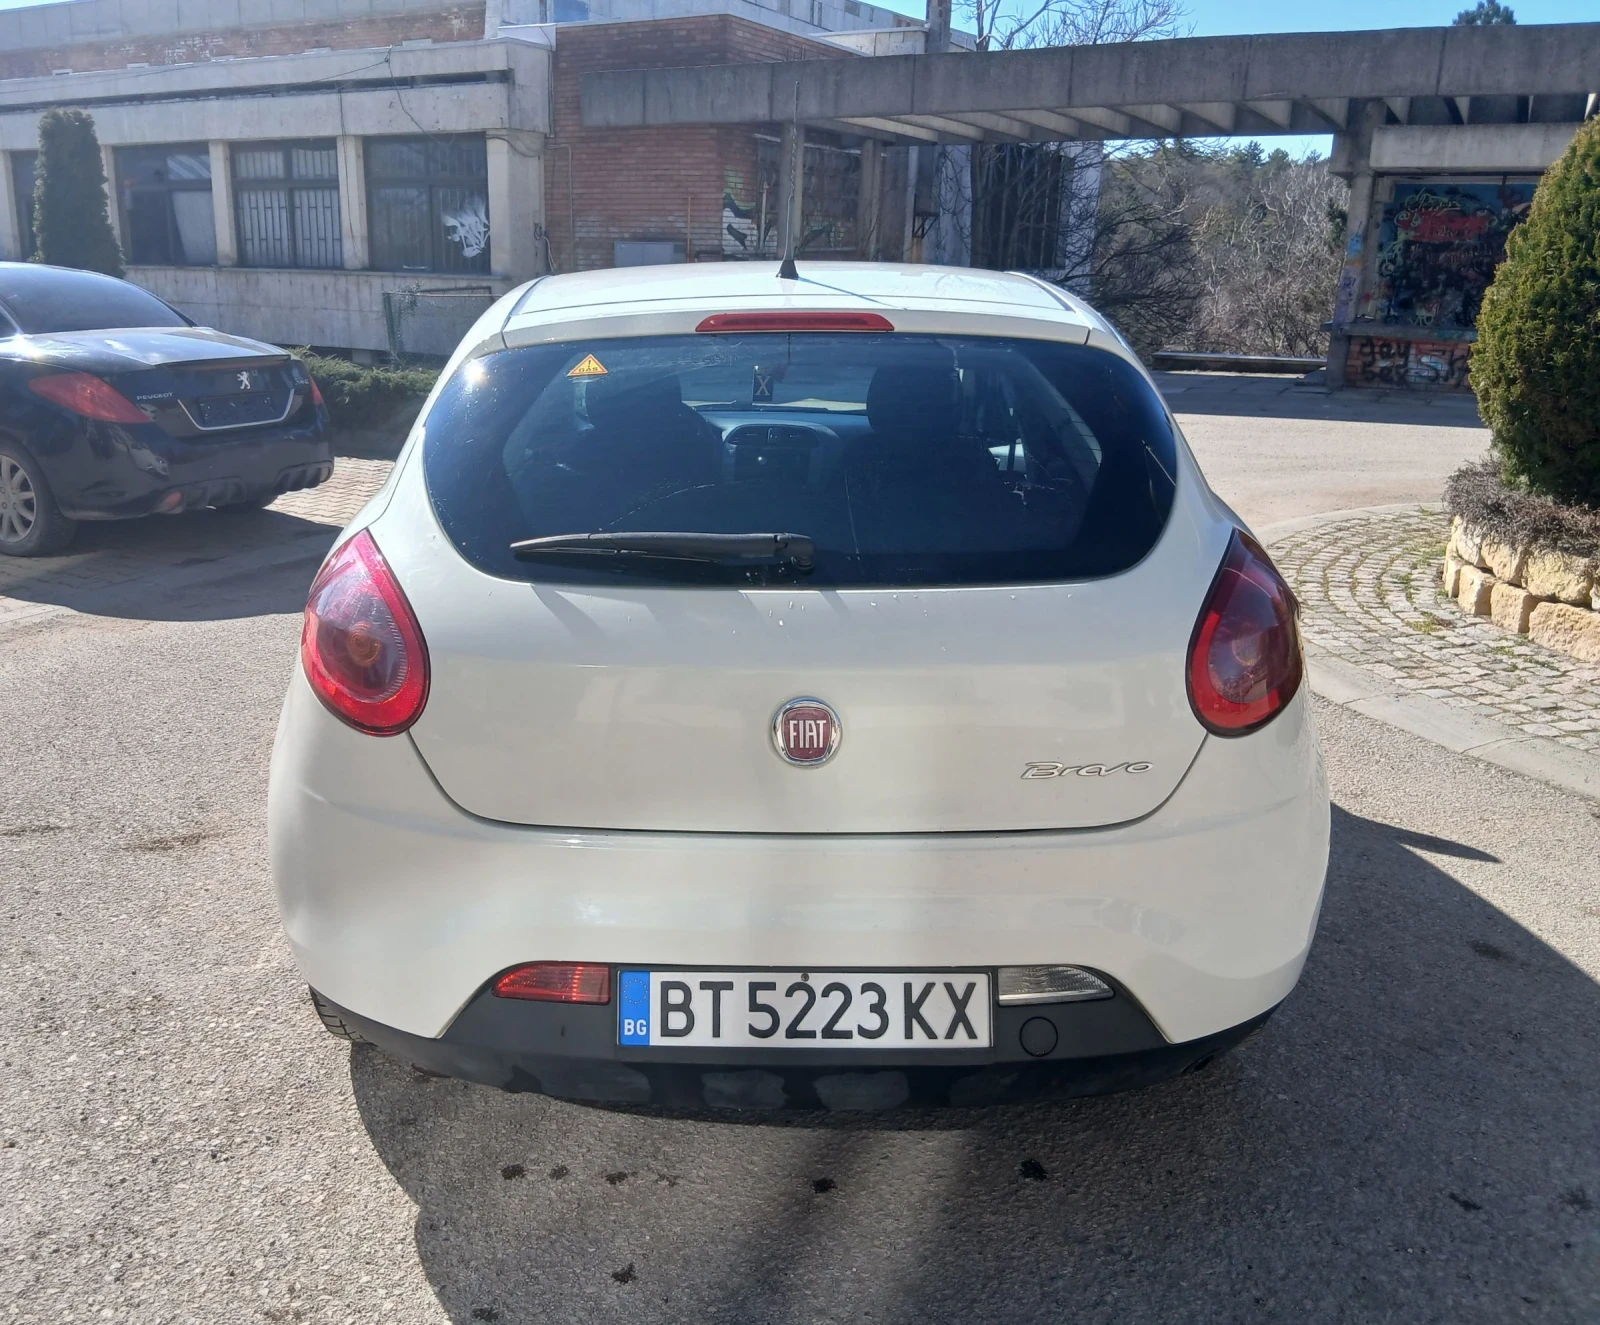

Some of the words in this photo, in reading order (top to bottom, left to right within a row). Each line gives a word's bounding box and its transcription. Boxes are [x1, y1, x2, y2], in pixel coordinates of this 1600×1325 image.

[136, 391, 174, 401] PEUGEOT
[789, 719, 827, 749] FIAT
[1020, 761, 1154, 779] Bravo
[660, 980, 734, 1038] BT
[748, 981, 890, 1039] 5223
[904, 981, 979, 1040] KX
[624, 1018, 647, 1036] BG
